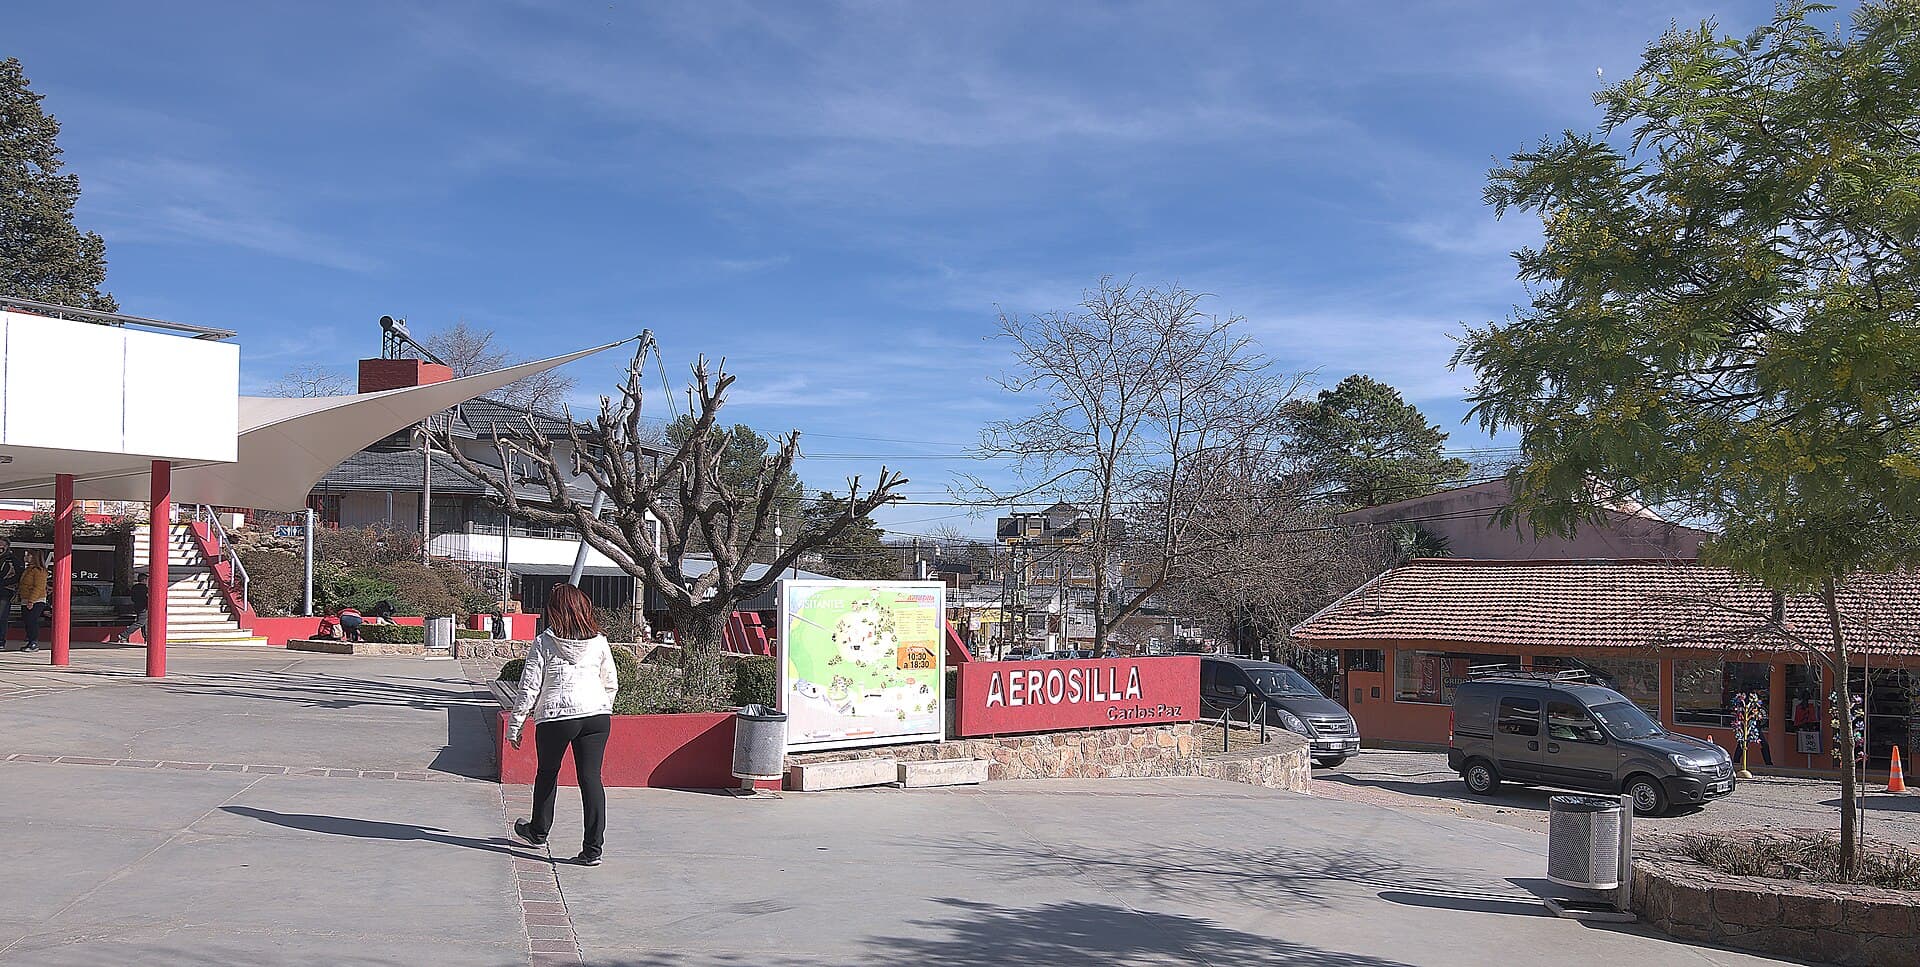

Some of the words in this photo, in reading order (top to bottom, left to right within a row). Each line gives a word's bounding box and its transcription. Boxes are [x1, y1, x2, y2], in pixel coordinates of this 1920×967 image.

[80, 570, 99, 579] Paz
[908, 652, 927, 661] 10:30
[911, 661, 930, 669] 18:30
[985, 666, 1143, 707] AEROSILLA
[1106, 704, 1155, 721] Carlos
[1157, 703, 1182, 718] Paz
